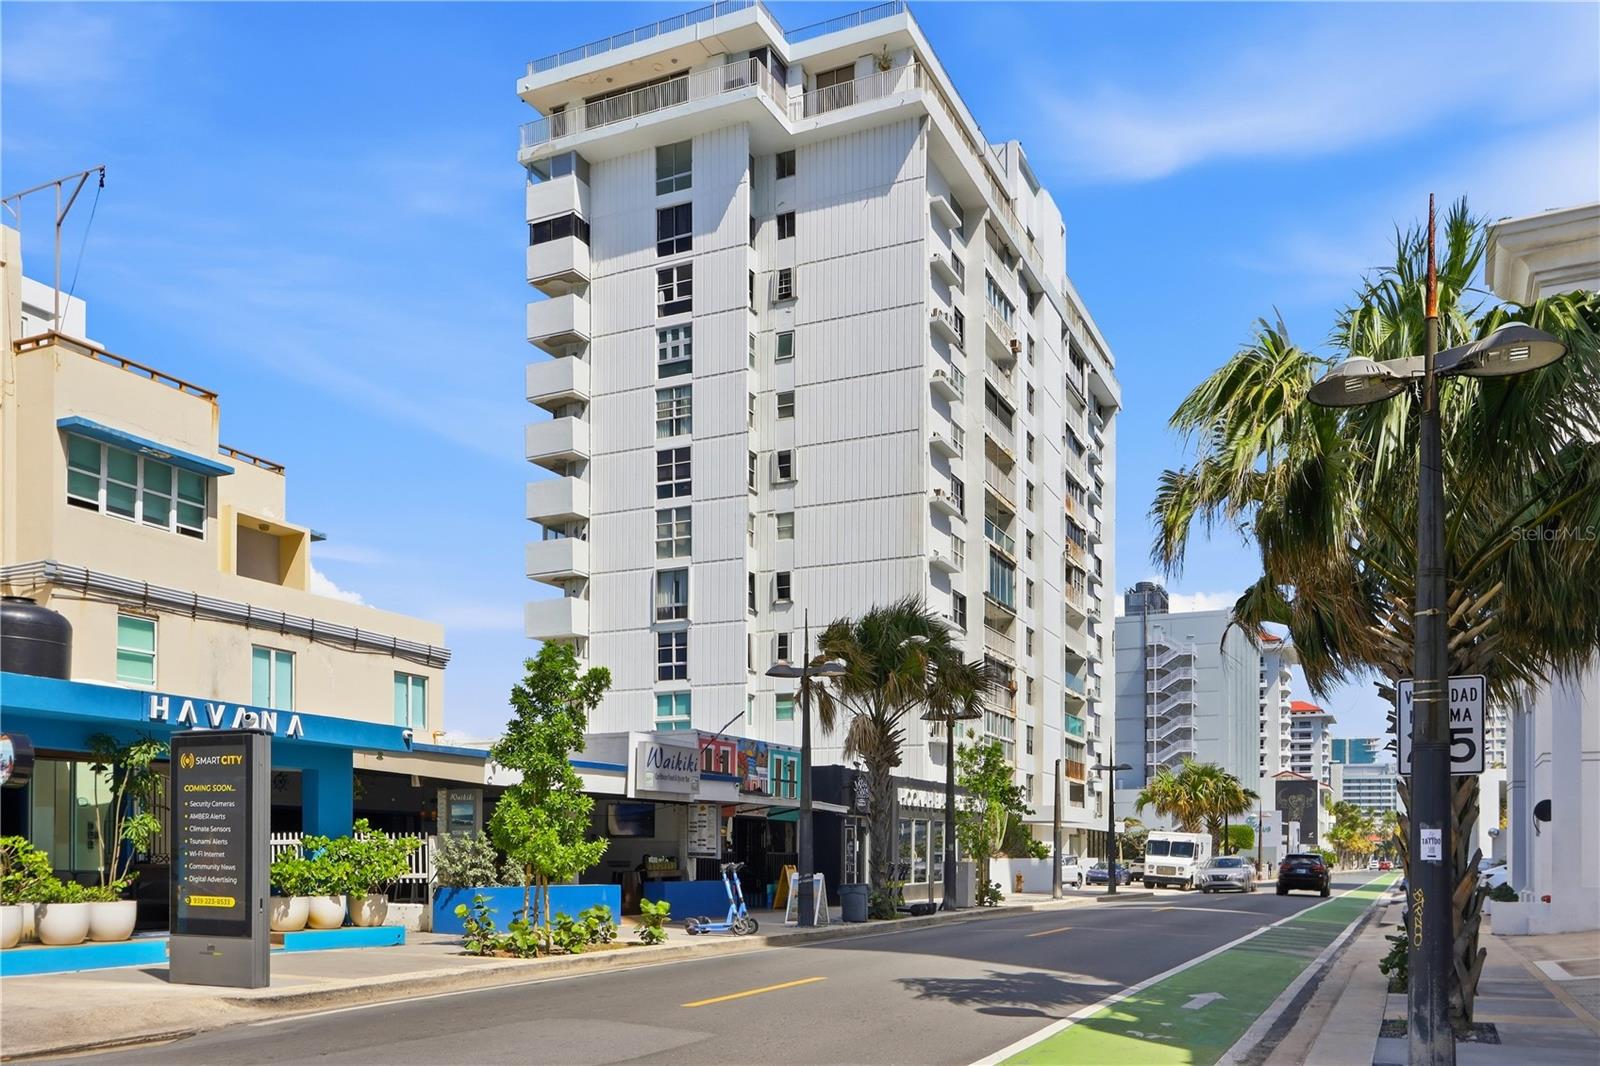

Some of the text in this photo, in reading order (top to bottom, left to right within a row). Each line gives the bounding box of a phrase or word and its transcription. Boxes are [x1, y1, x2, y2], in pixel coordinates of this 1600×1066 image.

[149, 695, 304, 738] HAVANA
[647, 746, 698, 773] Waikiki
[189, 863, 220, 871] Community
[189, 875, 238, 885] Digital Advertising
